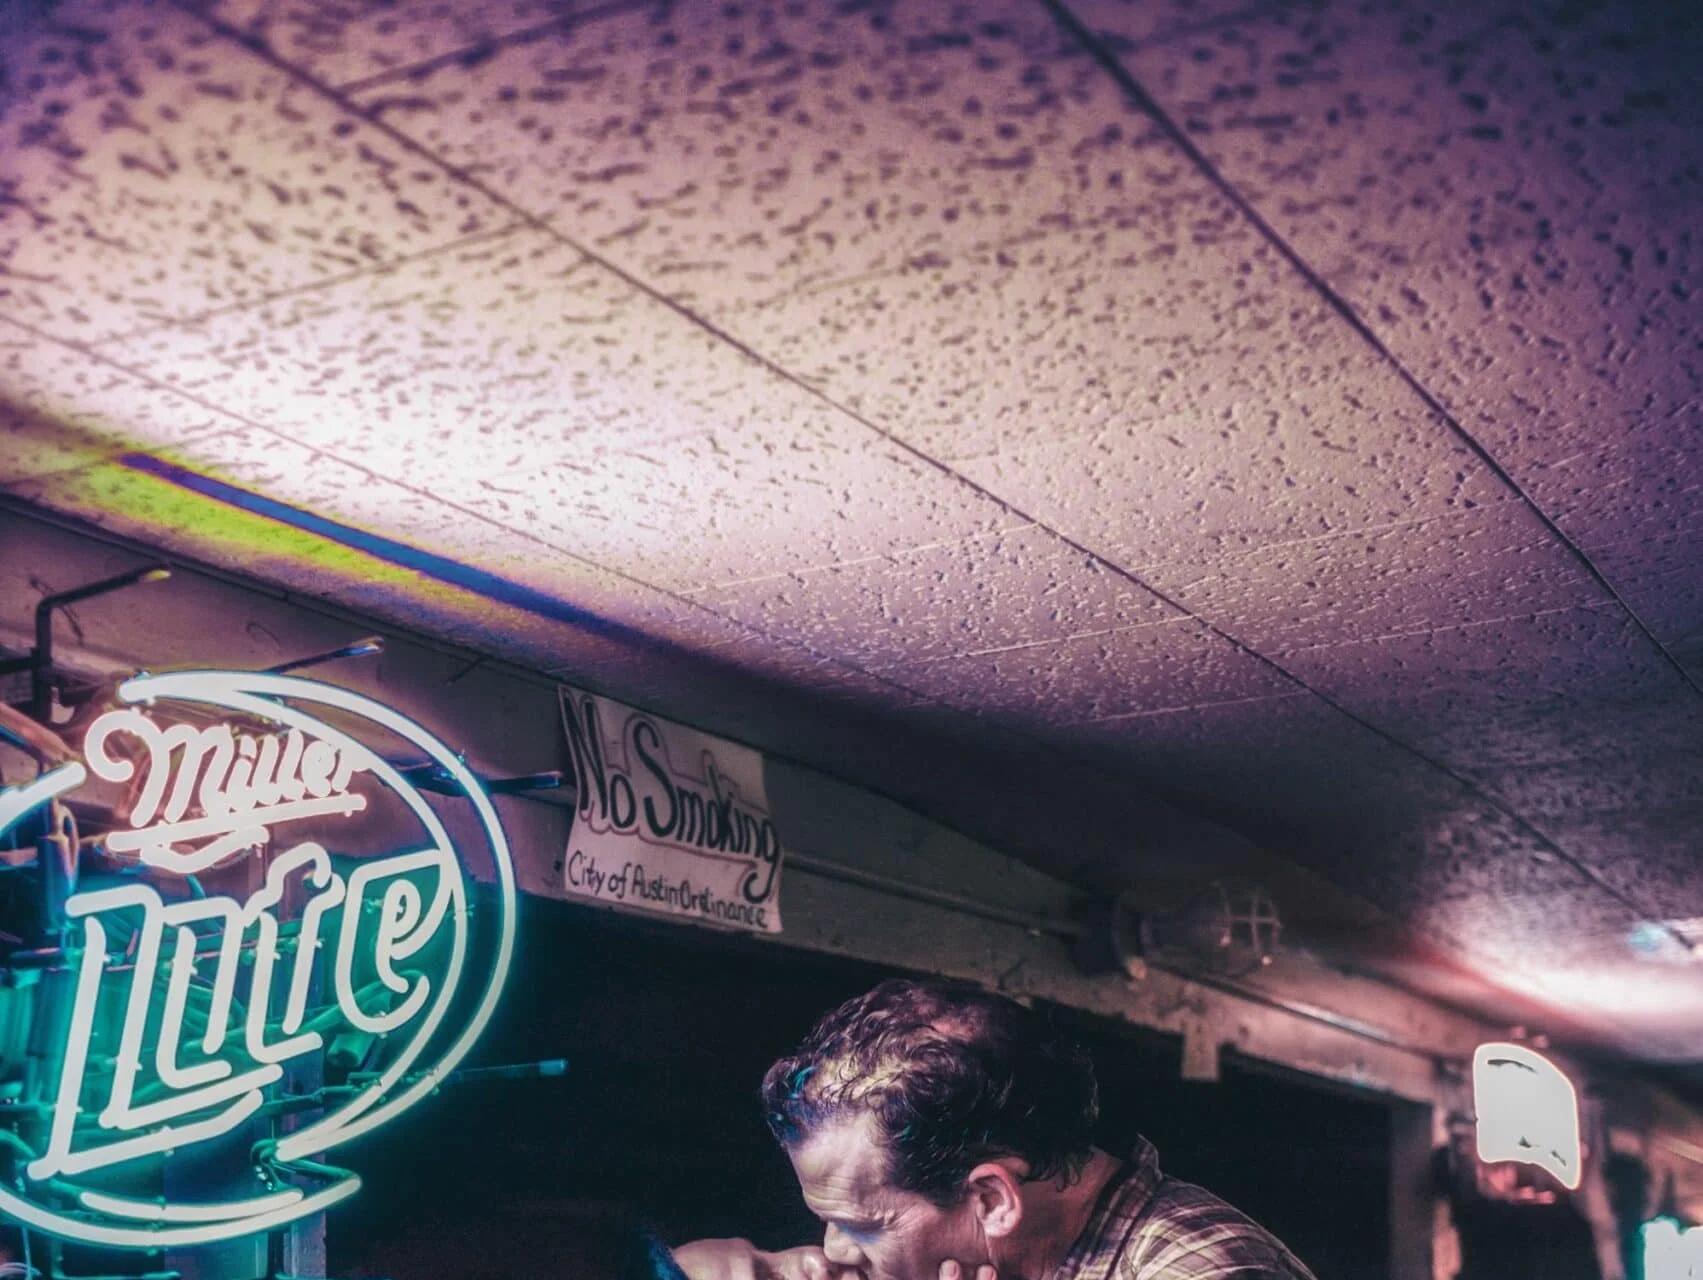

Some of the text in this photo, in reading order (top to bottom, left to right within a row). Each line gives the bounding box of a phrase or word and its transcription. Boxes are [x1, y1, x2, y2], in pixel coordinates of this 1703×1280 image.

[84, 708, 367, 834] Miller
[562, 695, 781, 904] No Smoking
[567, 850, 769, 929] City of Austin Ordinance
